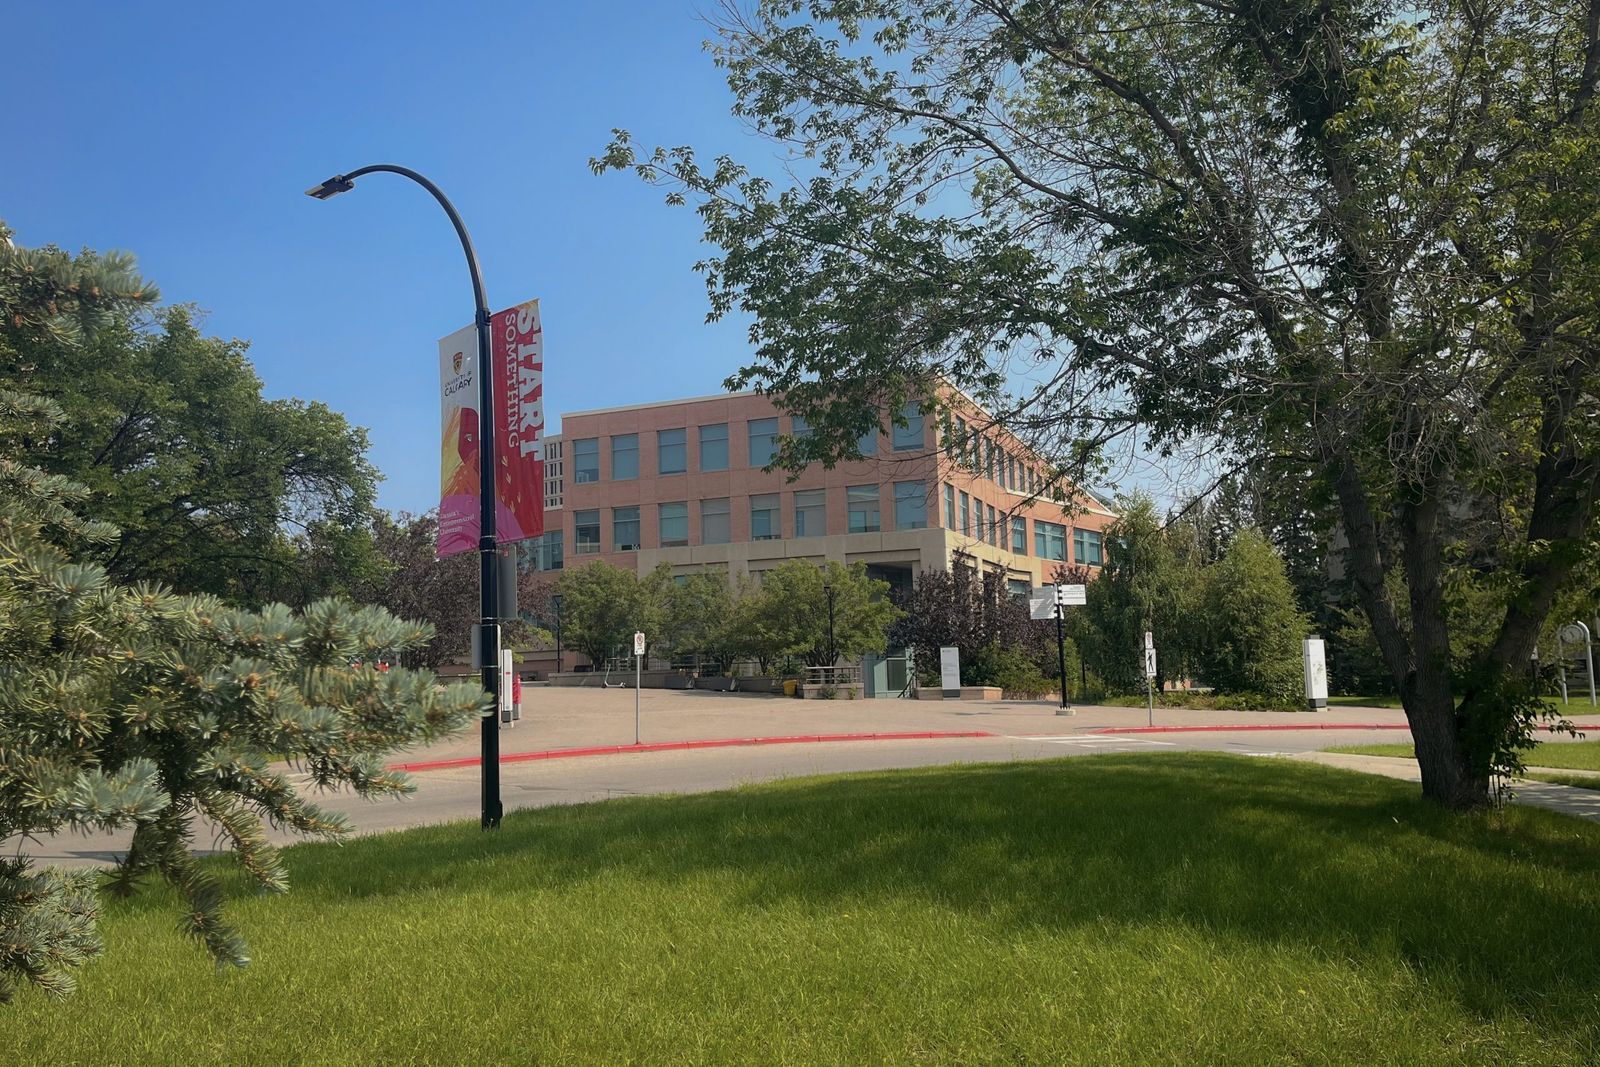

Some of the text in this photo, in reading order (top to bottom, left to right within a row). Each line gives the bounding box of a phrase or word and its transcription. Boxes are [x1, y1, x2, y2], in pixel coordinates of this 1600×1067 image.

[444, 377, 472, 397] CALGARY
[506, 313, 519, 448] SOMETHING
[517, 302, 544, 461] START
